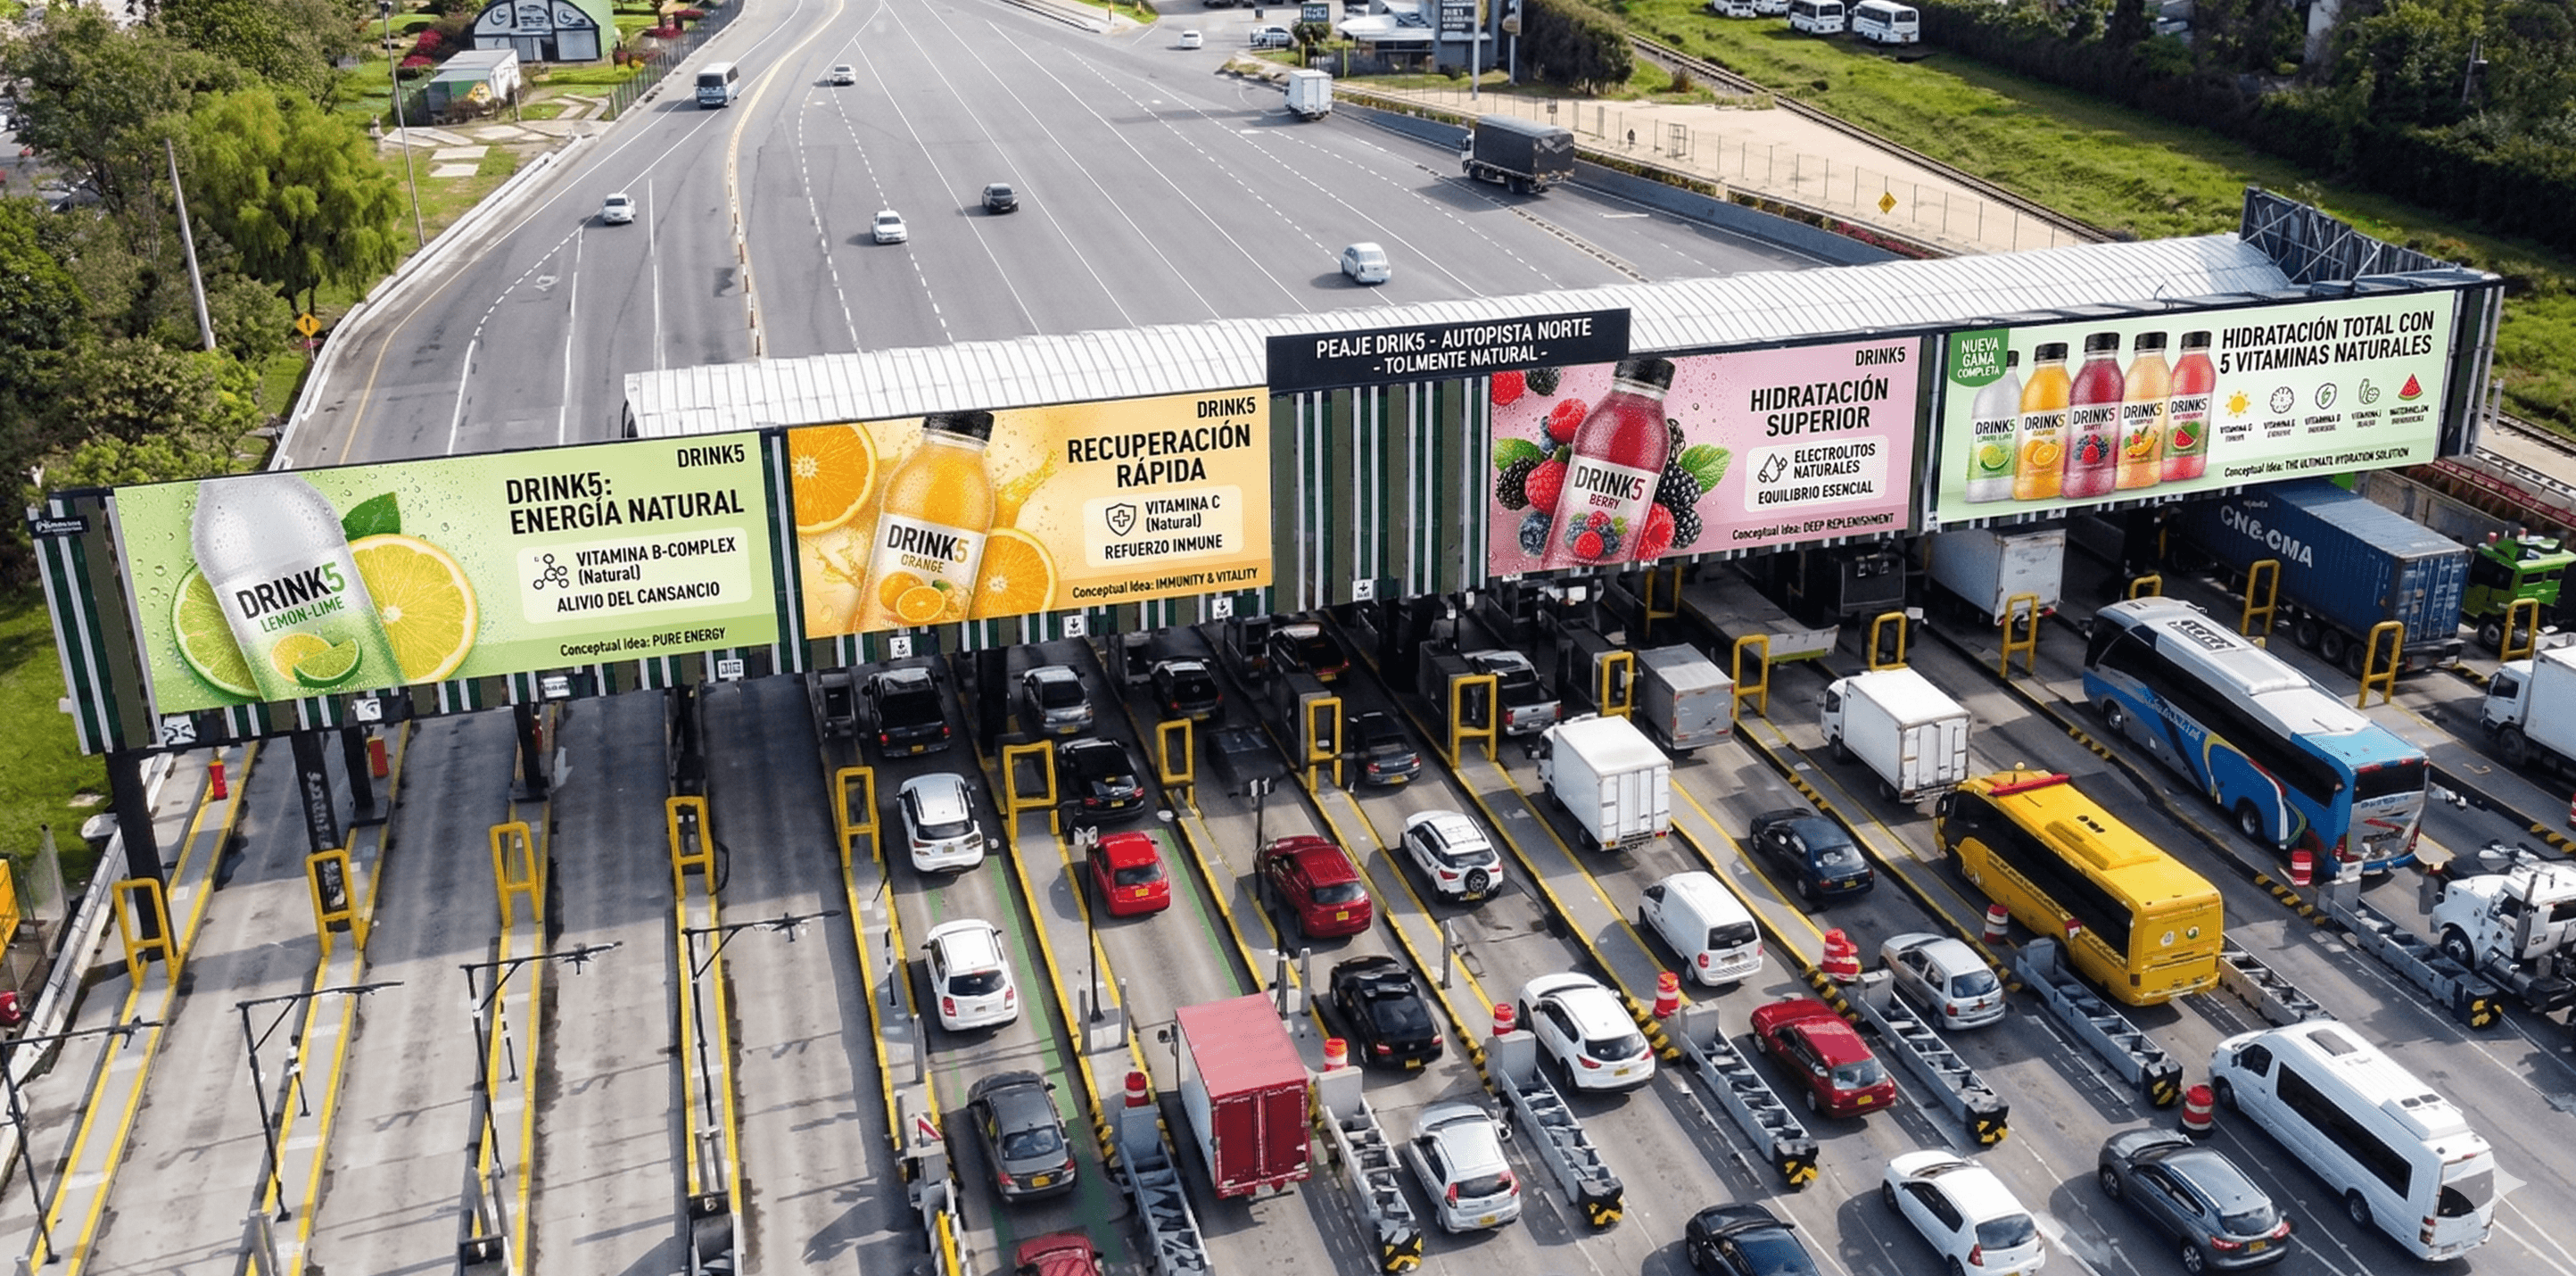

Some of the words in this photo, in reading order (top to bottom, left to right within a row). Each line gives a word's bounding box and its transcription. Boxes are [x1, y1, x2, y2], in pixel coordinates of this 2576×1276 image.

[1317, 336, 1372, 359] PEAJE
[1376, 333, 1425, 353] DRIK5
[1441, 323, 1532, 348] AUTOPISTA
[1538, 318, 1592, 339] NORTE
[1961, 337, 1999, 353] NUEVA
[2222, 316, 2338, 350] HIDRATACIÓN
[2343, 314, 2394, 338] TOTAL
[2399, 311, 2435, 333] CON
[1384, 352, 1466, 374] TOLMENTE
[1470, 344, 1539, 365] NATURAL
[1855, 346, 1905, 367] DRINK5
[2219, 353, 2231, 375] 5
[2236, 344, 2330, 372] VITAMINAS
[2334, 334, 2432, 363] NATURALES
[1957, 365, 2000, 378] COMPLETA
[1198, 396, 1256, 418] DRINK5
[1750, 373, 1888, 412] HIDRATACIÓN
[1766, 405, 1870, 437] SUPERIOR
[677, 444, 745, 468] DRINK5
[1068, 419, 1251, 464] RECUPERACIÓN
[1795, 443, 1876, 463] ELECTROLITOS
[1117, 457, 1207, 488] RÁPIDA
[1574, 466, 1646, 501] DRINK5
[1794, 460, 1861, 479] NATURALES
[506, 472, 612, 505] DRINK5:
[1589, 493, 1621, 510] BERRY
[1758, 485, 1820, 505] EQUILIBRIO
[1822, 480, 1874, 497] ESENCIAL
[510, 496, 623, 534] ENERGÍA
[628, 489, 745, 523] NATURAL
[1145, 499, 1210, 516] VITAMINA
[1211, 495, 1221, 510] C
[1145, 512, 1201, 533] (Natural)
[576, 545, 648, 567] VITAMINA
[652, 536, 737, 559] B-COMPLEX
[887, 524, 970, 564] DRINK5
[1105, 540, 1169, 559] REFUERZO
[1172, 534, 1223, 552] INMUNE
[235, 561, 346, 619] DRINK5
[579, 564, 641, 586] (Natural)
[1073, 581, 1128, 599] Conceptual
[1156, 573, 1206, 590] IMMUNITY
[1207, 573, 1216, 584] &
[1216, 568, 1258, 584] VITALITY
[557, 592, 604, 613] ALIVIO
[607, 590, 634, 608] DEL
[637, 581, 721, 604] CANSANCIO
[260, 595, 345, 633] LEMON-LIME
[560, 638, 622, 657] Conceptual
[623, 634, 650, 650] Idea:
[653, 631, 681, 647] PURE
[684, 626, 726, 643] ENERGY
